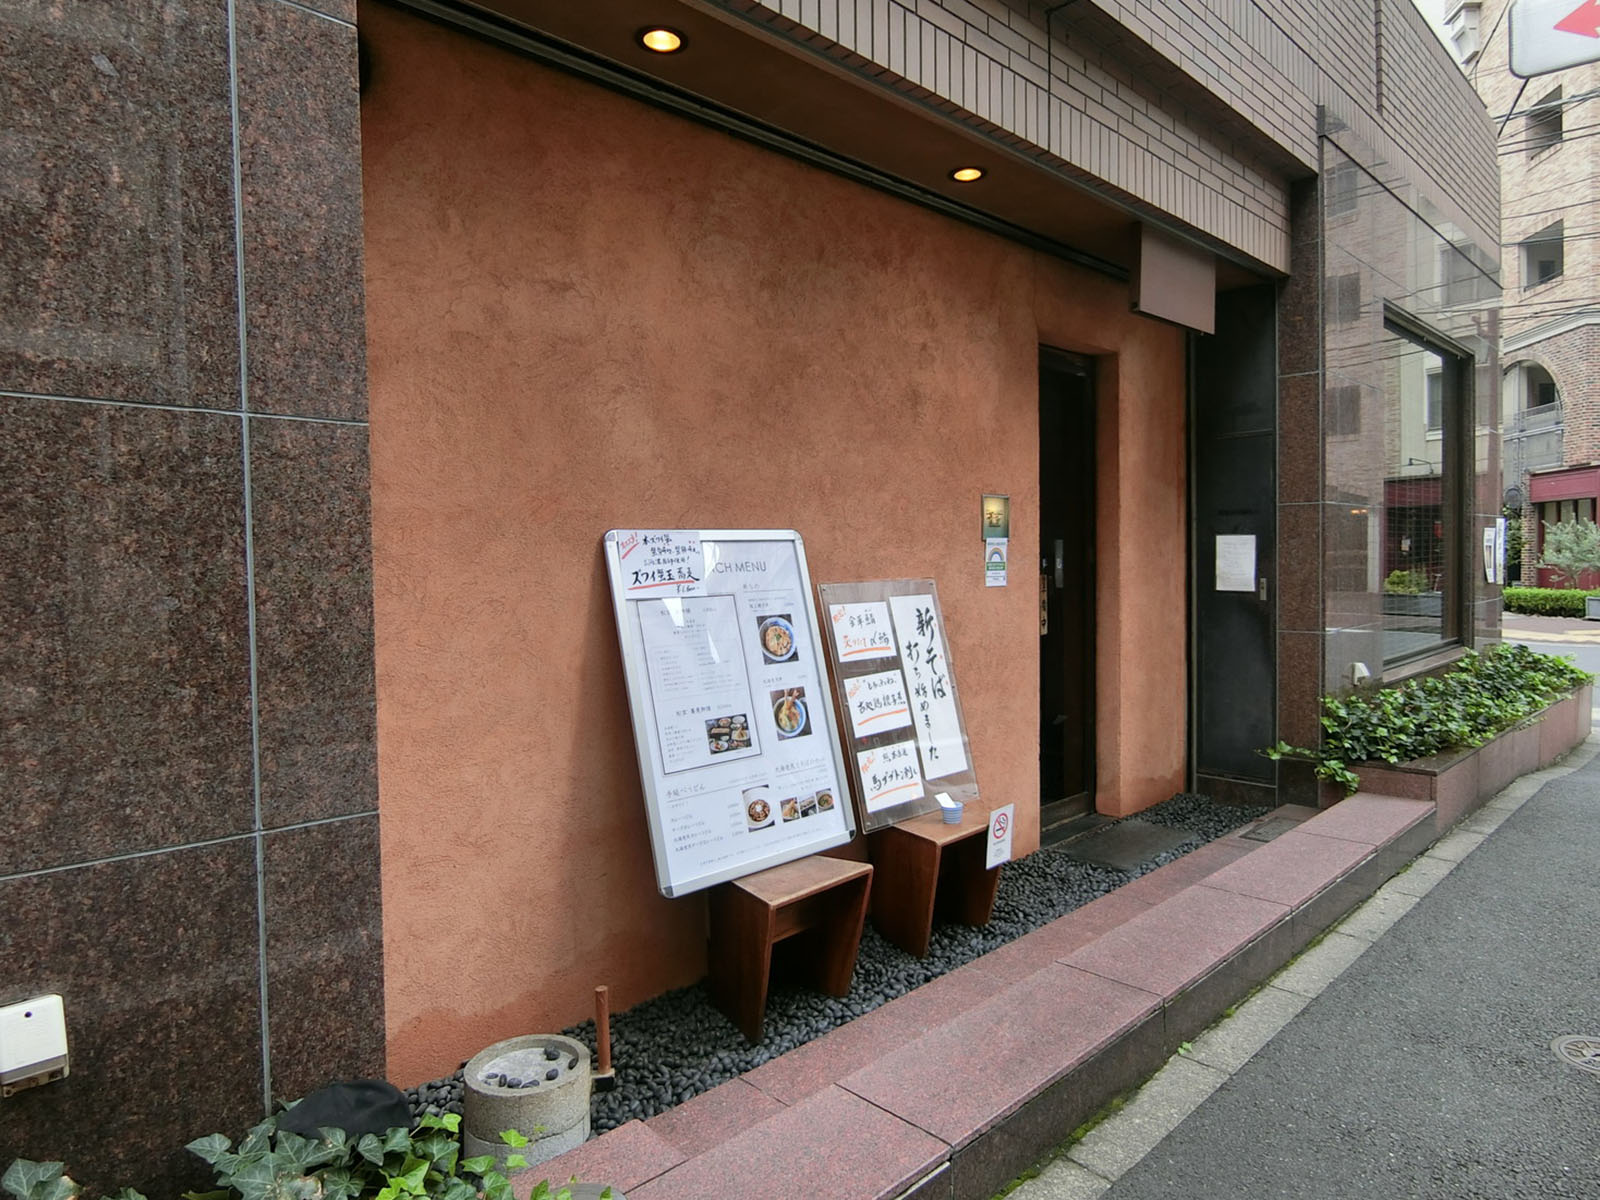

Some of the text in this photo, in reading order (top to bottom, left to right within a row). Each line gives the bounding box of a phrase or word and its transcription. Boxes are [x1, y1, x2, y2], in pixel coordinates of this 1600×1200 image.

[631, 567, 701, 586] ズワイ蟹玉蕎麦
[735, 561, 767, 573] MENU
[916, 607, 947, 700] 新そば
[905, 640, 939, 761] 打ち始めました
